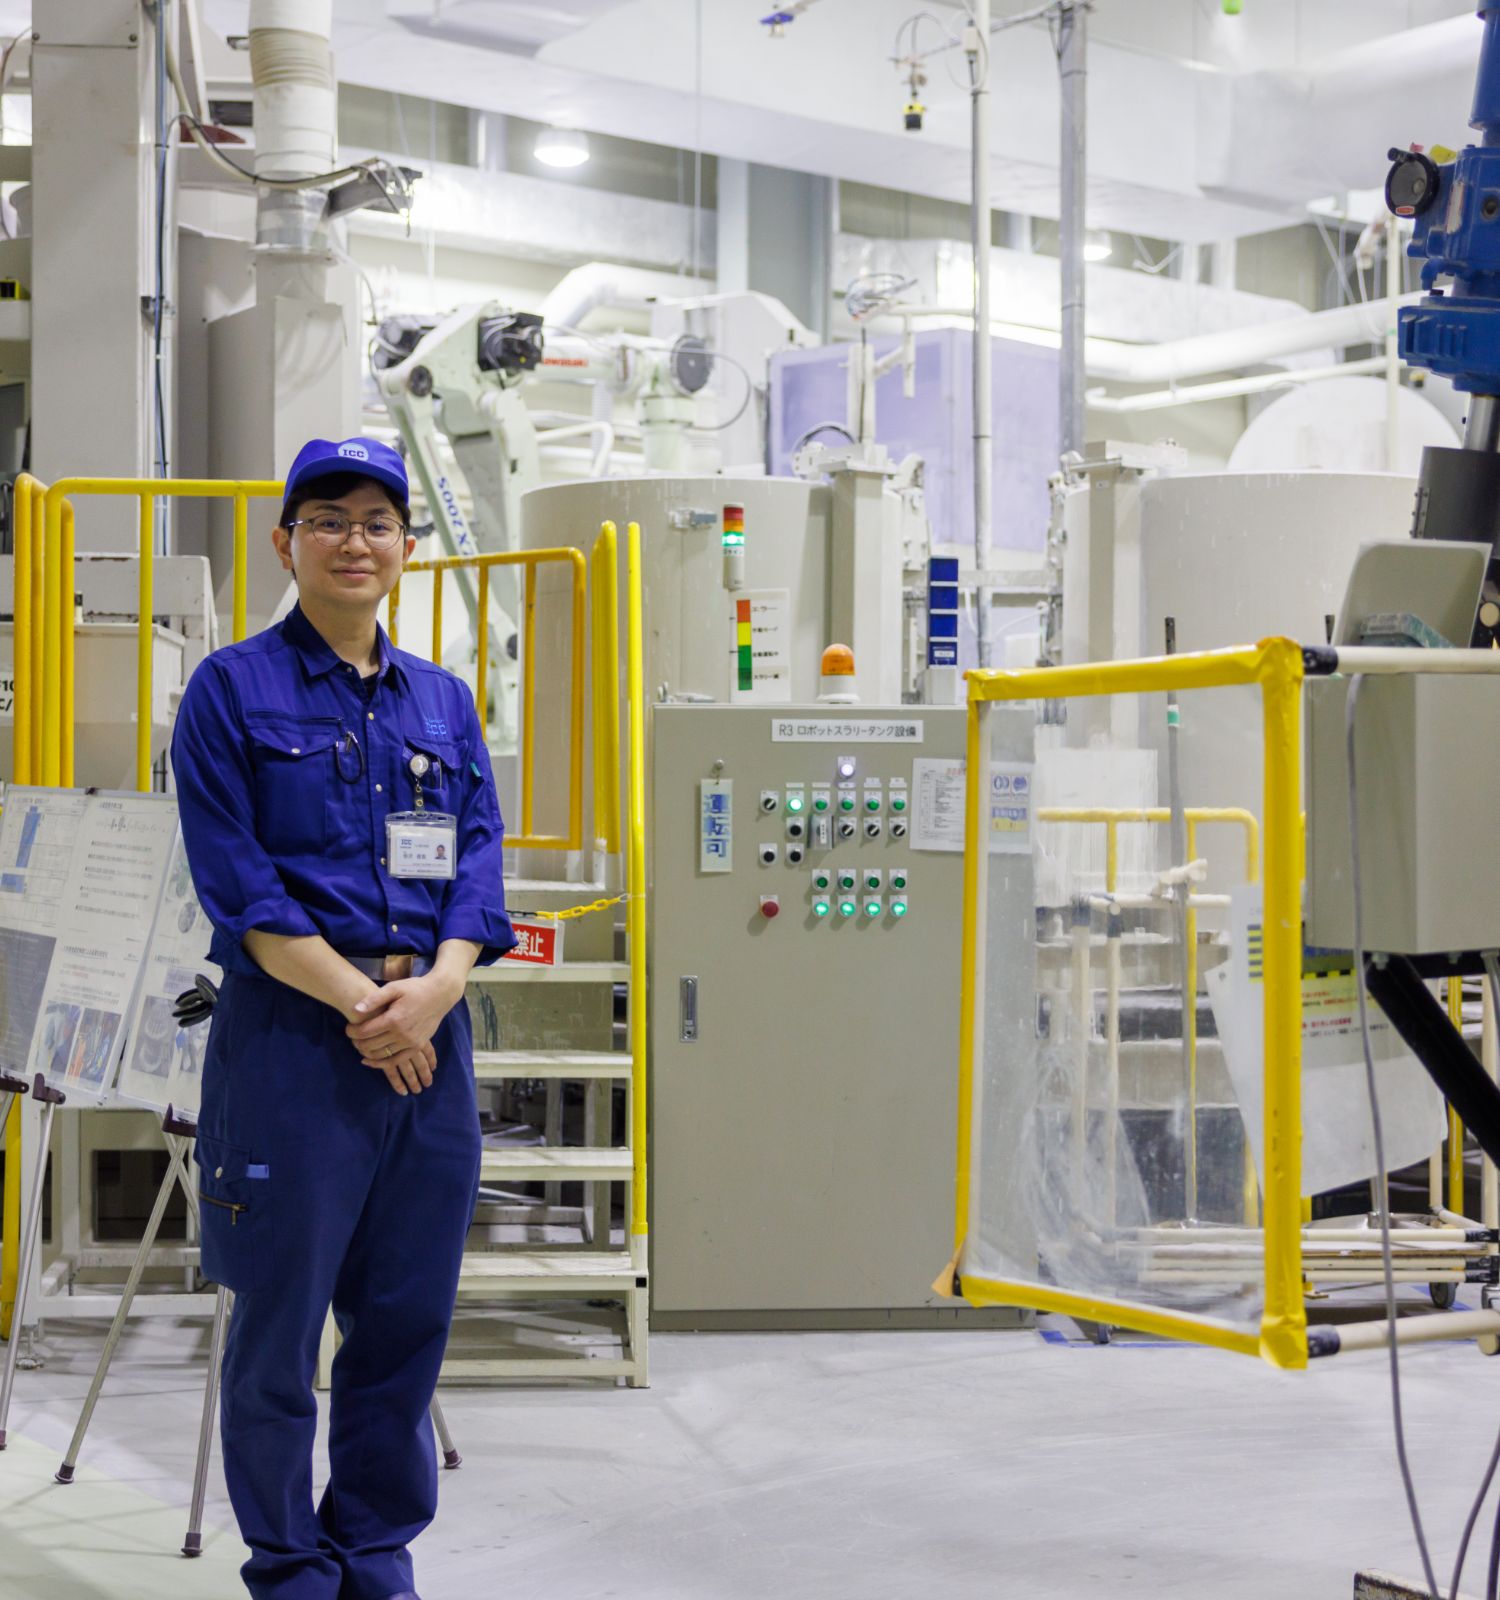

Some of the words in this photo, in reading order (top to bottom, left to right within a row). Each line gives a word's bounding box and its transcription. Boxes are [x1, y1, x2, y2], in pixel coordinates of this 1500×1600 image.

[343, 449, 364, 458] ICC
[779, 724, 793, 736] R3
[797, 725, 917, 737] ロボットスラリータンク設備
[511, 929, 544, 957] 禁止
